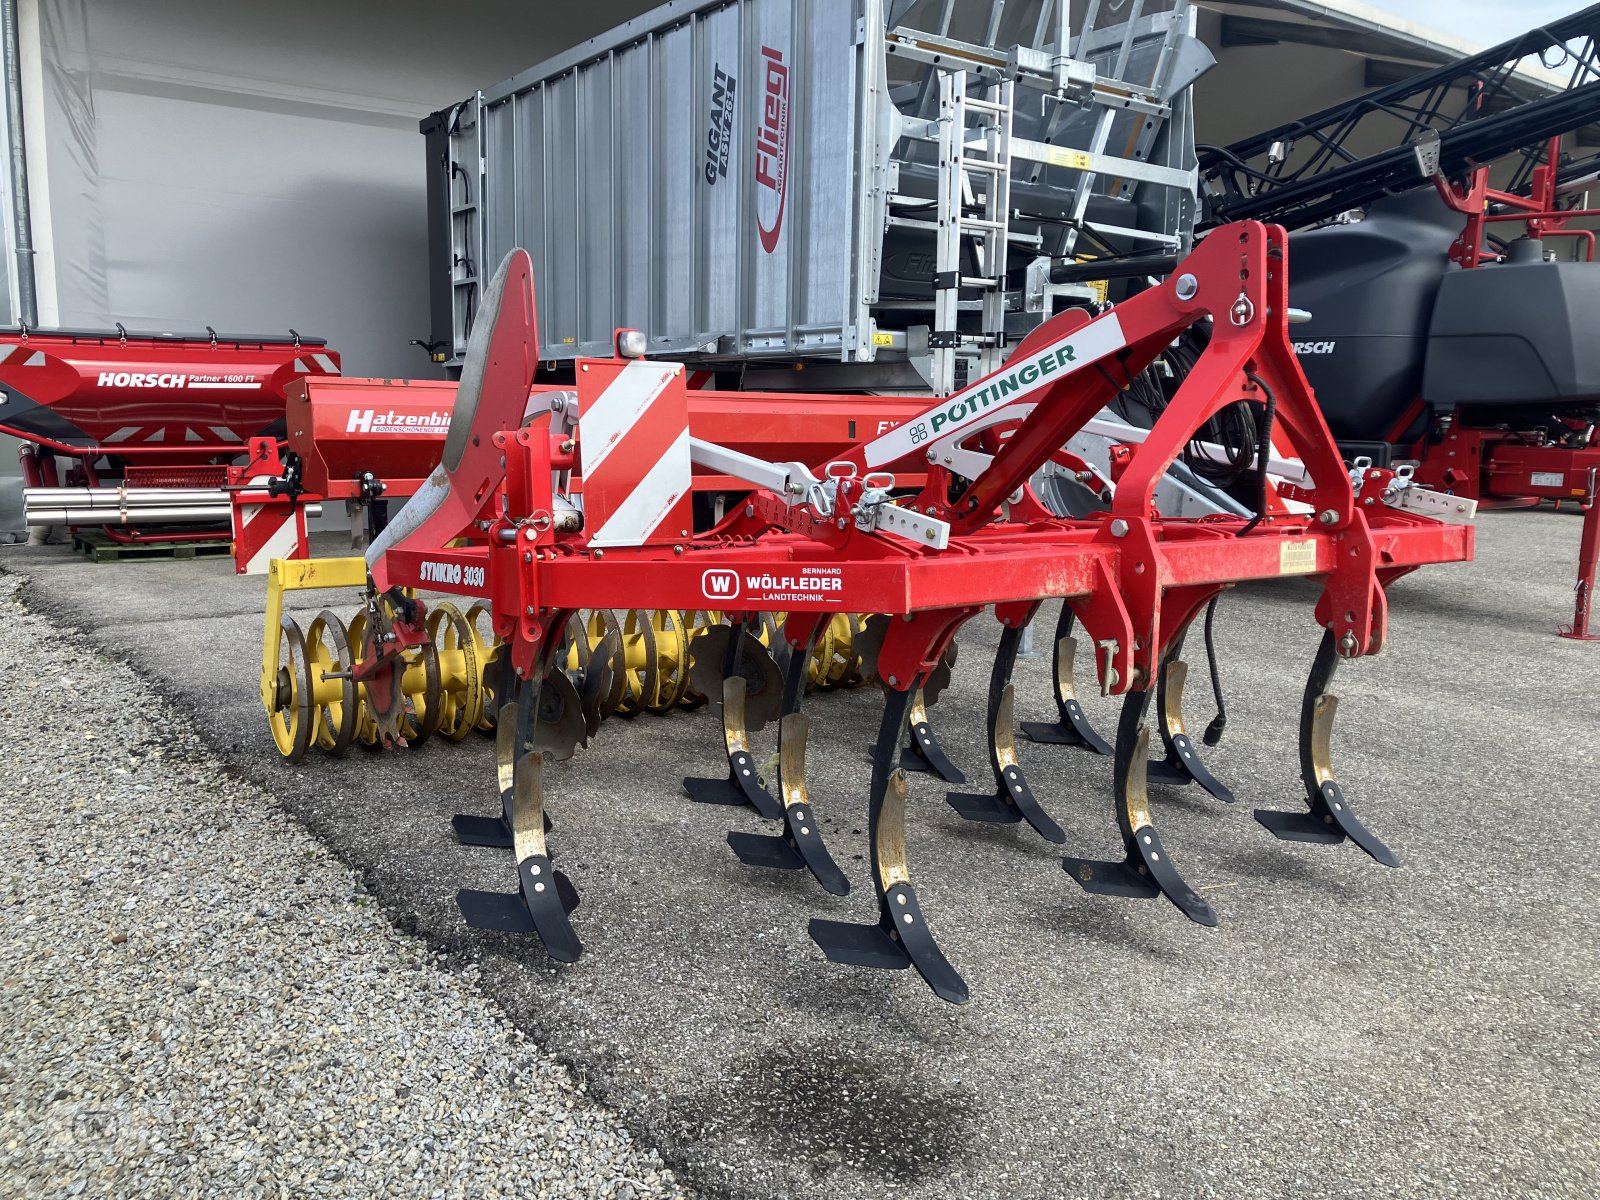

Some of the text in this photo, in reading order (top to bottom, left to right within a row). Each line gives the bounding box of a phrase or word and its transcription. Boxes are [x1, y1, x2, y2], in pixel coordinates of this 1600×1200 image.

[705, 62, 727, 186] GIGANT
[720, 90, 735, 168] ASW 261
[755, 45, 788, 190] Fliegl
[777, 101, 787, 195] AGRARTECHNIK
[1290, 341, 1336, 354] RSCH
[97, 372, 186, 388] HORSCH
[188, 374, 221, 382] Partner
[930, 344, 1077, 433] PÖTTINGER
[420, 561, 485, 588] SYNKRO 3030
[746, 574, 842, 591] WÖLFLEDER
[762, 592, 824, 602] LANDTECHNIK
